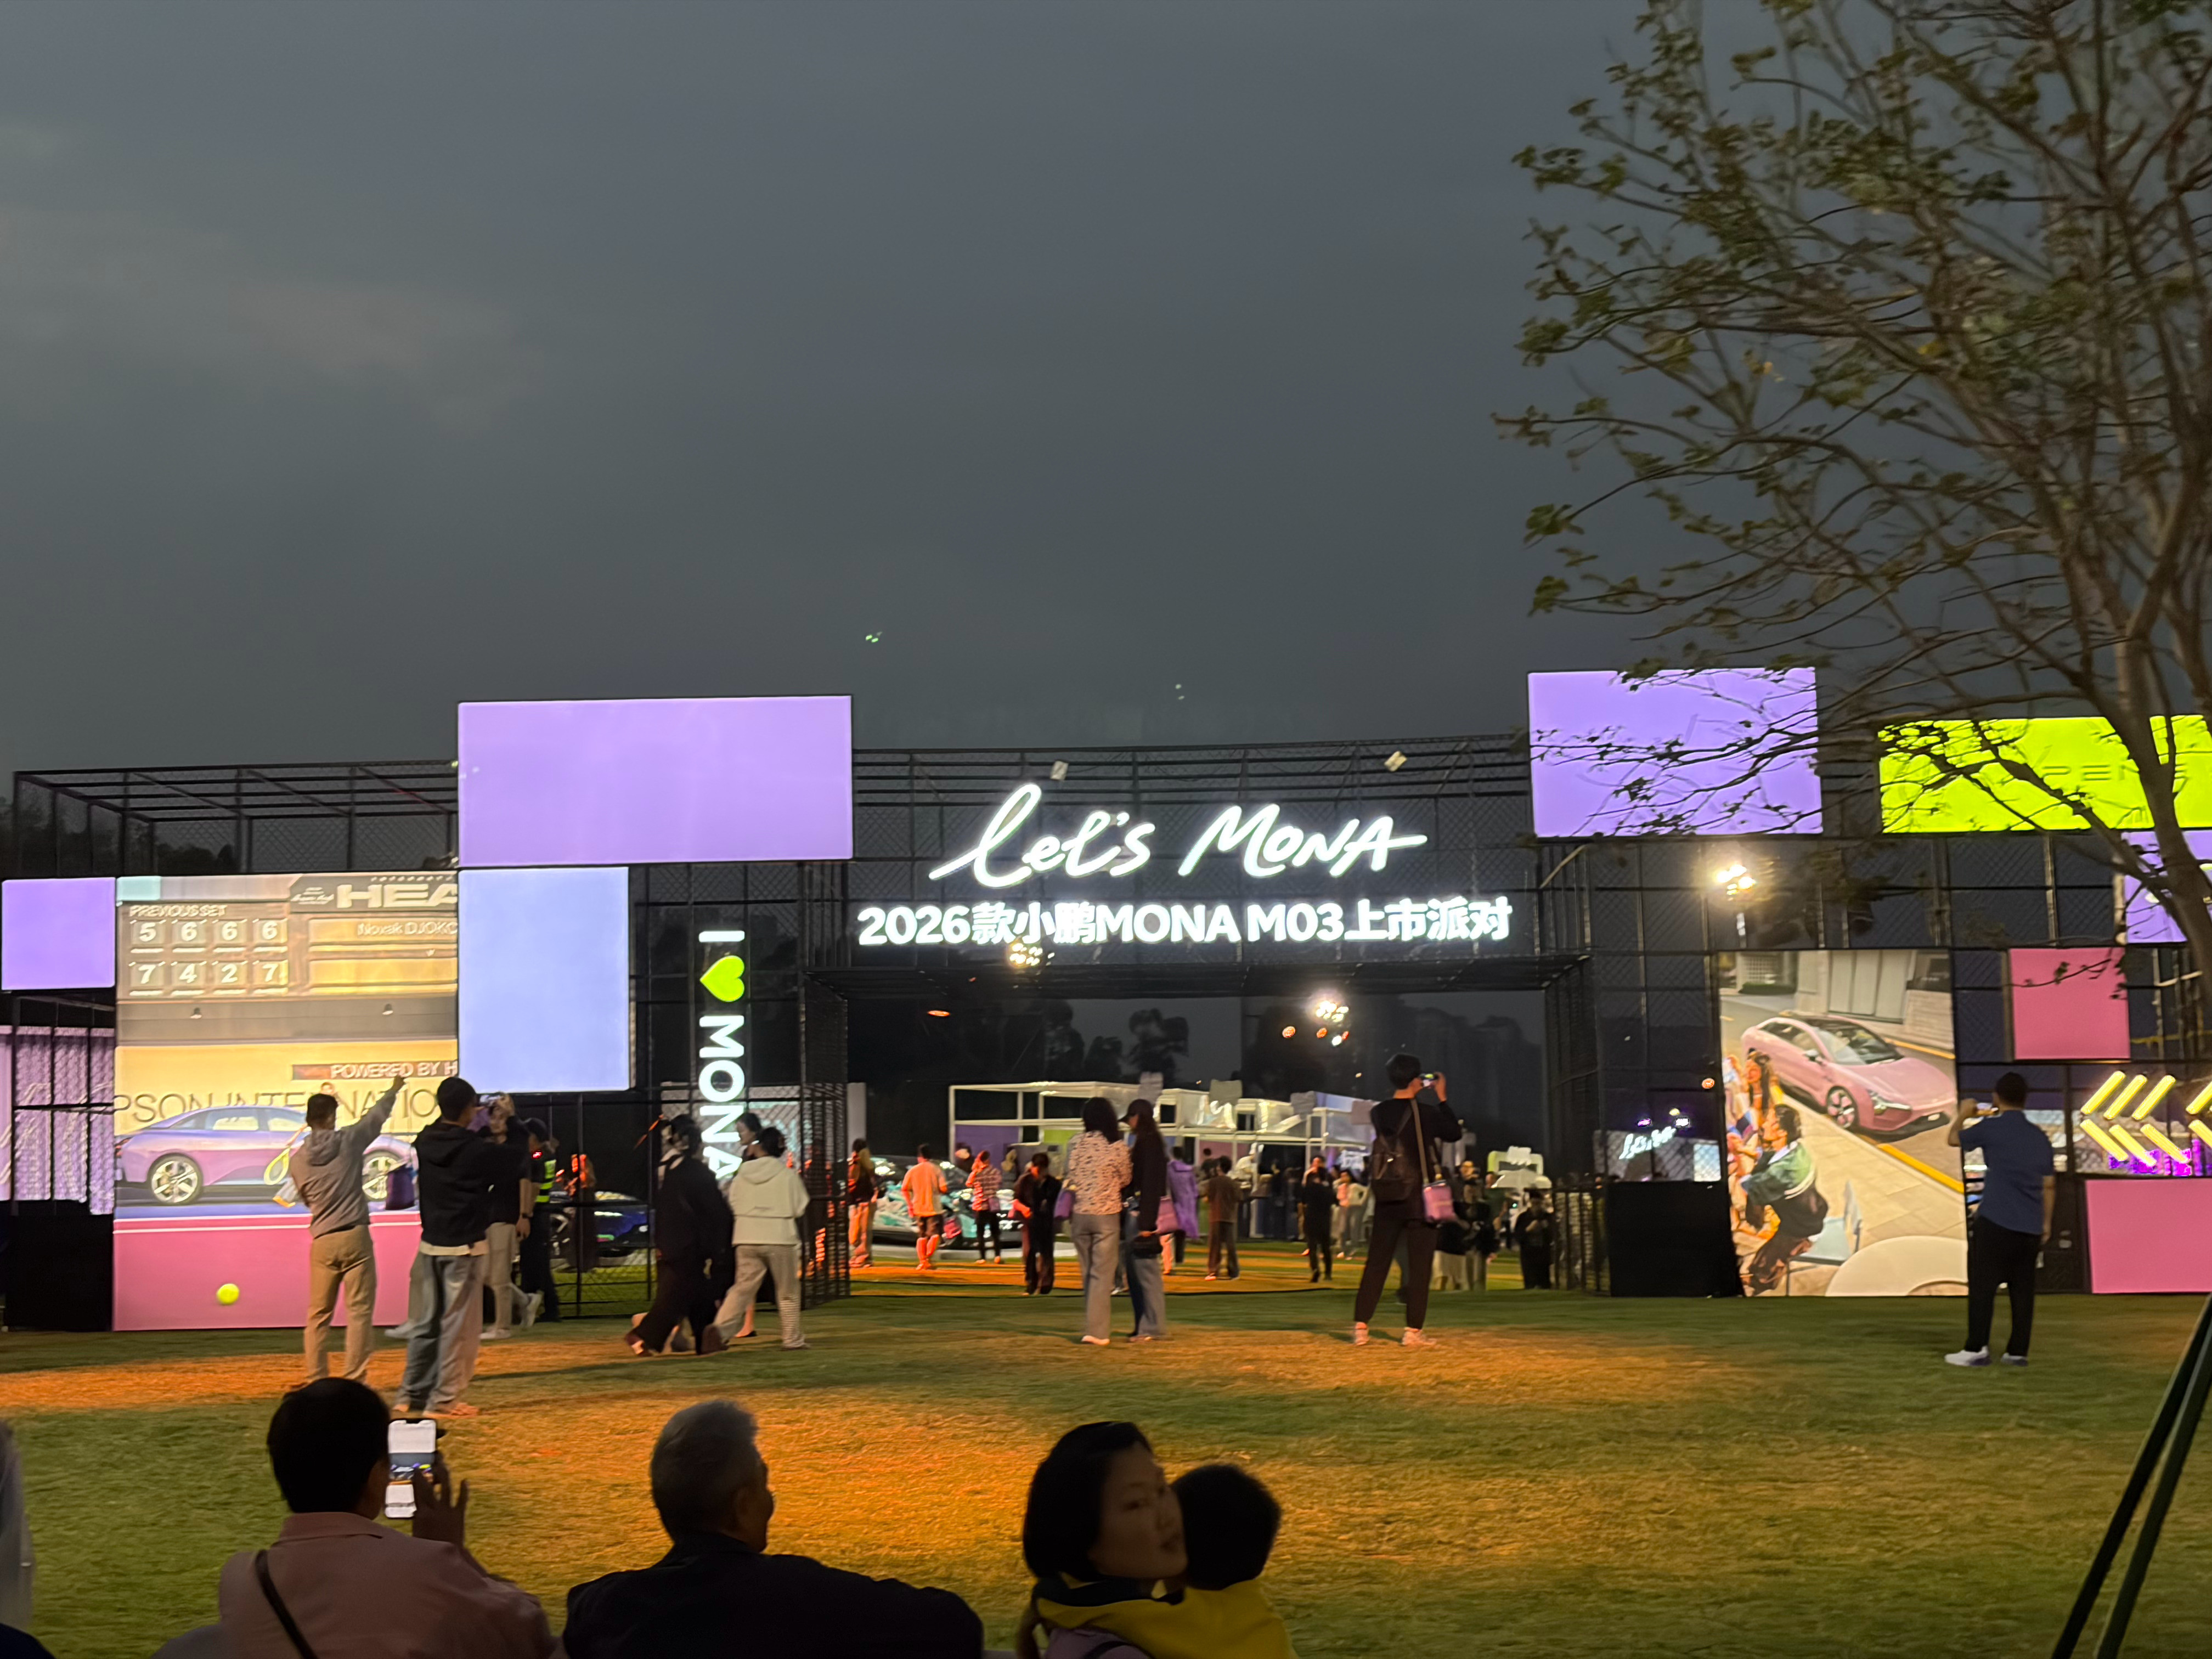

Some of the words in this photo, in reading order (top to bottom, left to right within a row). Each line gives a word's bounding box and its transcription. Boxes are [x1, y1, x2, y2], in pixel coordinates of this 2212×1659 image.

[199, 905, 228, 917] SET
[857, 900, 1242, 946] 2026款小鹏MONA
[1246, 895, 1513, 943] M03上市派对
[139, 922, 156, 942] 5
[180, 921, 198, 941] 6
[222, 921, 238, 941] 6
[262, 921, 278, 940] 6
[698, 930, 746, 943] I
[138, 964, 156, 984] 7
[179, 963, 198, 983] 4
[221, 963, 238, 983] 2
[262, 963, 279, 982] 7
[330, 1062, 414, 1079] POWERED
[417, 1062, 441, 1077] BY
[698, 1015, 746, 1180] MONA
